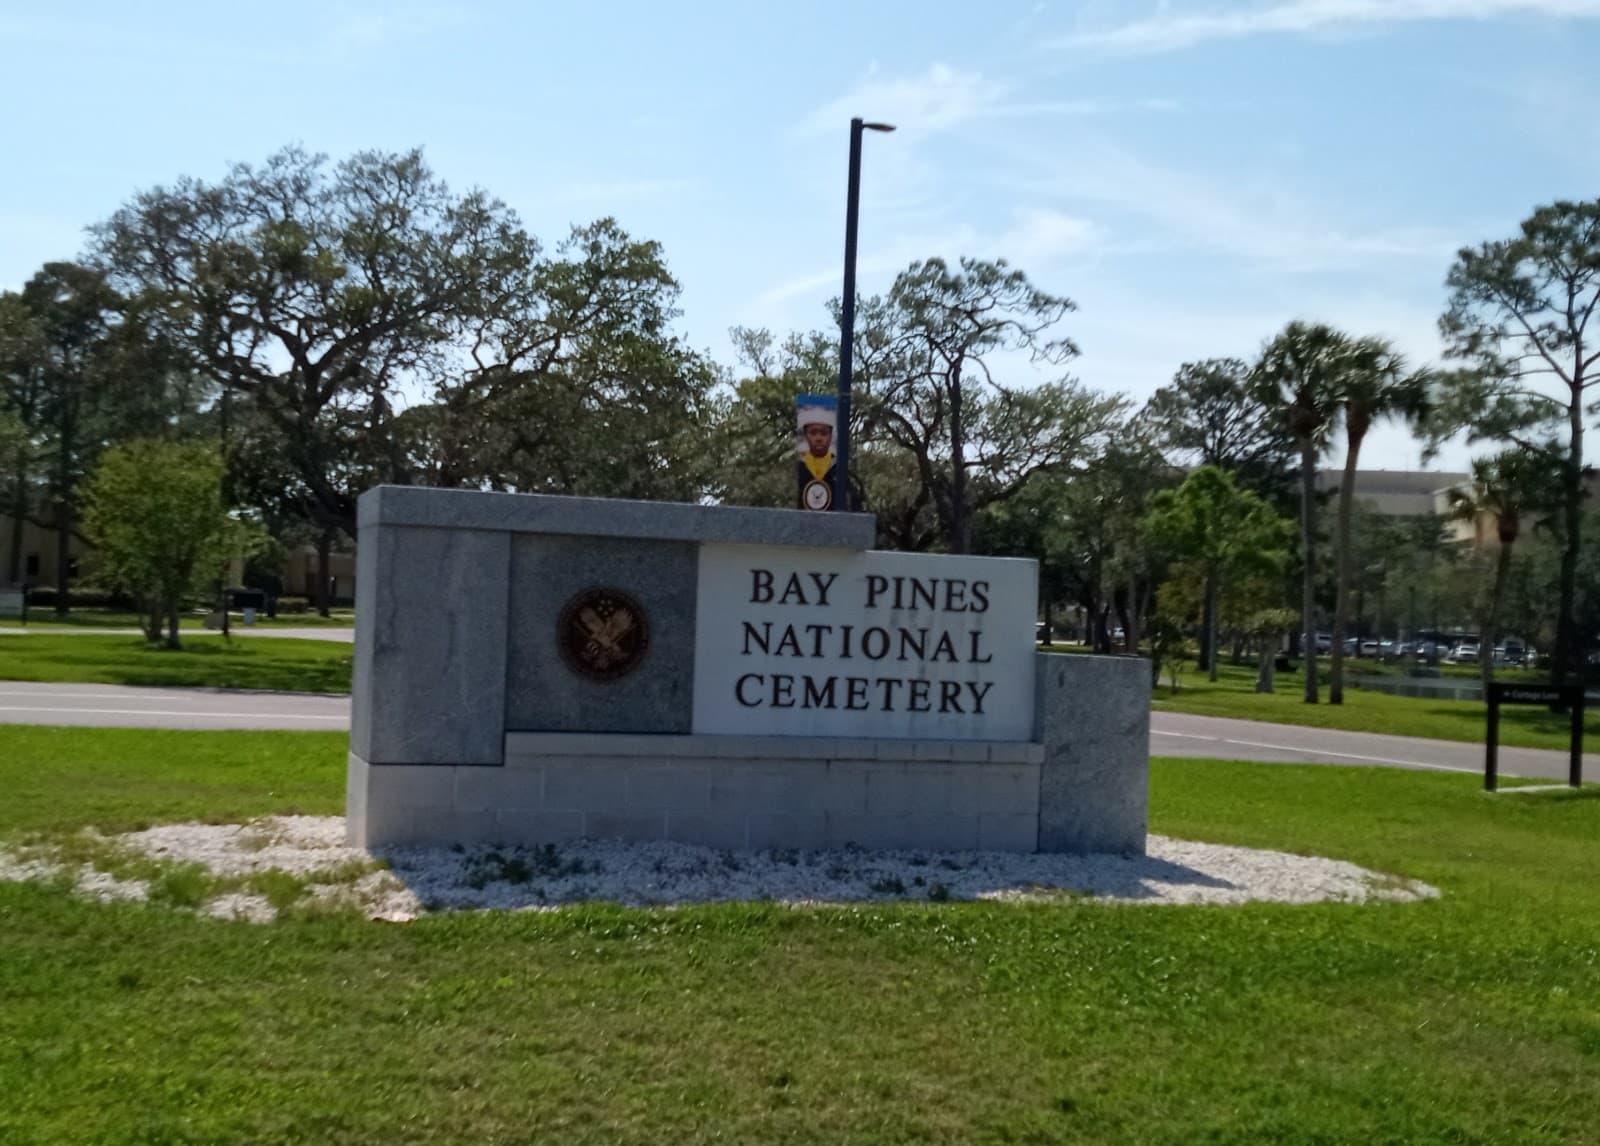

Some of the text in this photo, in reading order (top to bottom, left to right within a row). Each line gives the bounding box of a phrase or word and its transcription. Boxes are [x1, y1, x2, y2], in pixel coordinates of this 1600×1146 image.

[749, 568, 990, 615] BAY PINES
[740, 621, 993, 664] NATIONAL
[734, 673, 995, 714] CEMETERY
